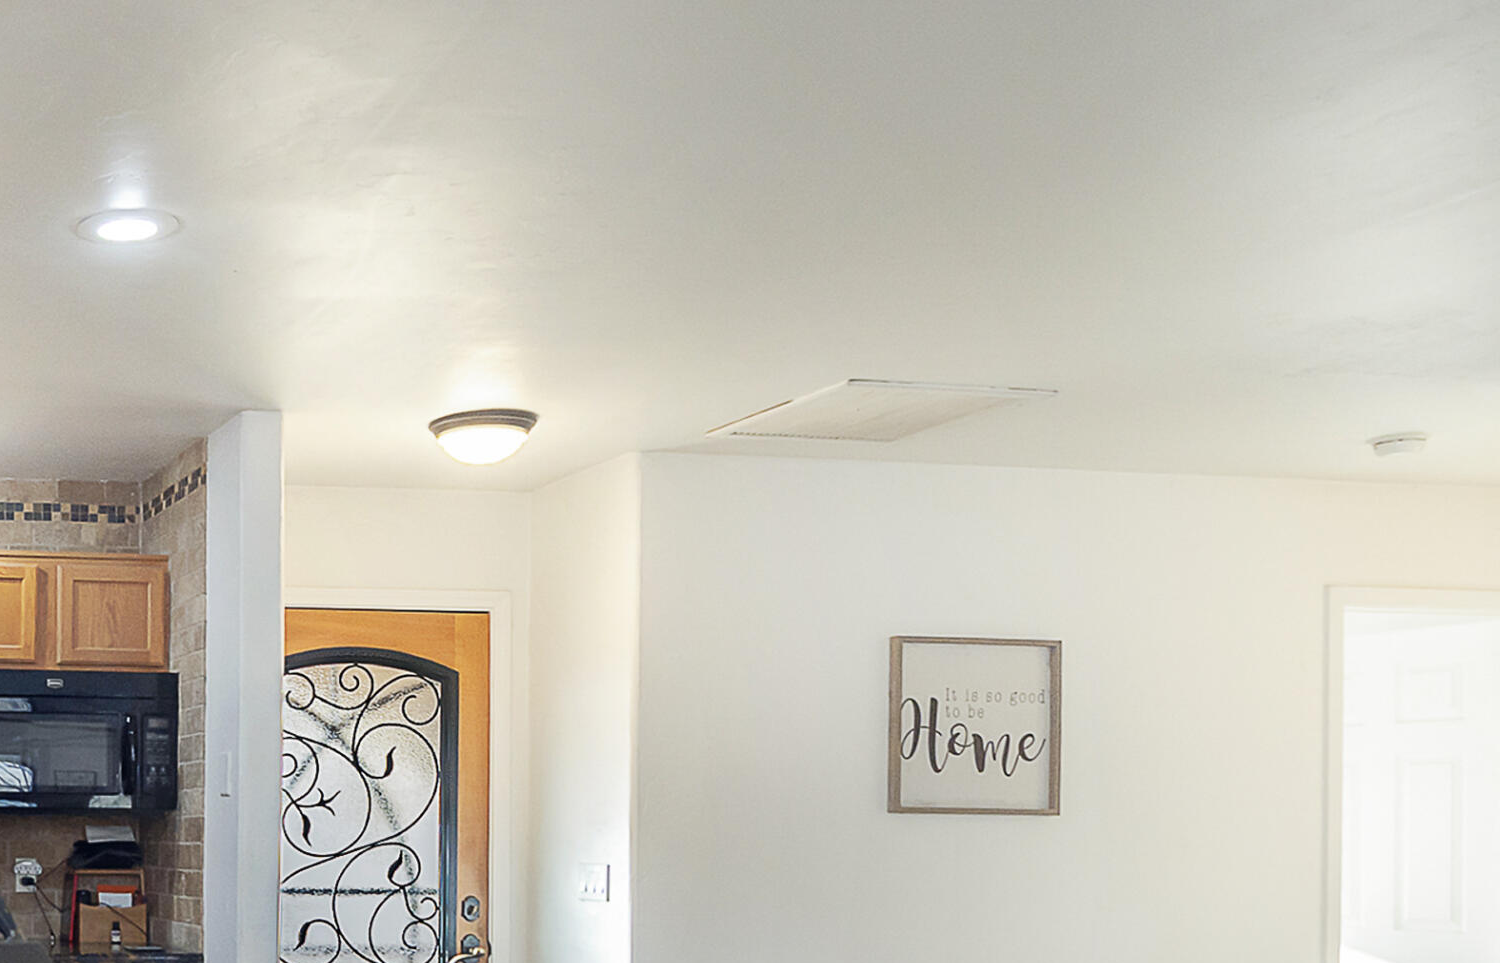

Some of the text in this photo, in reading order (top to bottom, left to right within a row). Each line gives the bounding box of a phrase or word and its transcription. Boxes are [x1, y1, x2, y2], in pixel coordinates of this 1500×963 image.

[945, 687, 1045, 706] It is so good
[945, 704, 984, 718] to be
[901, 697, 1046, 777] Home
